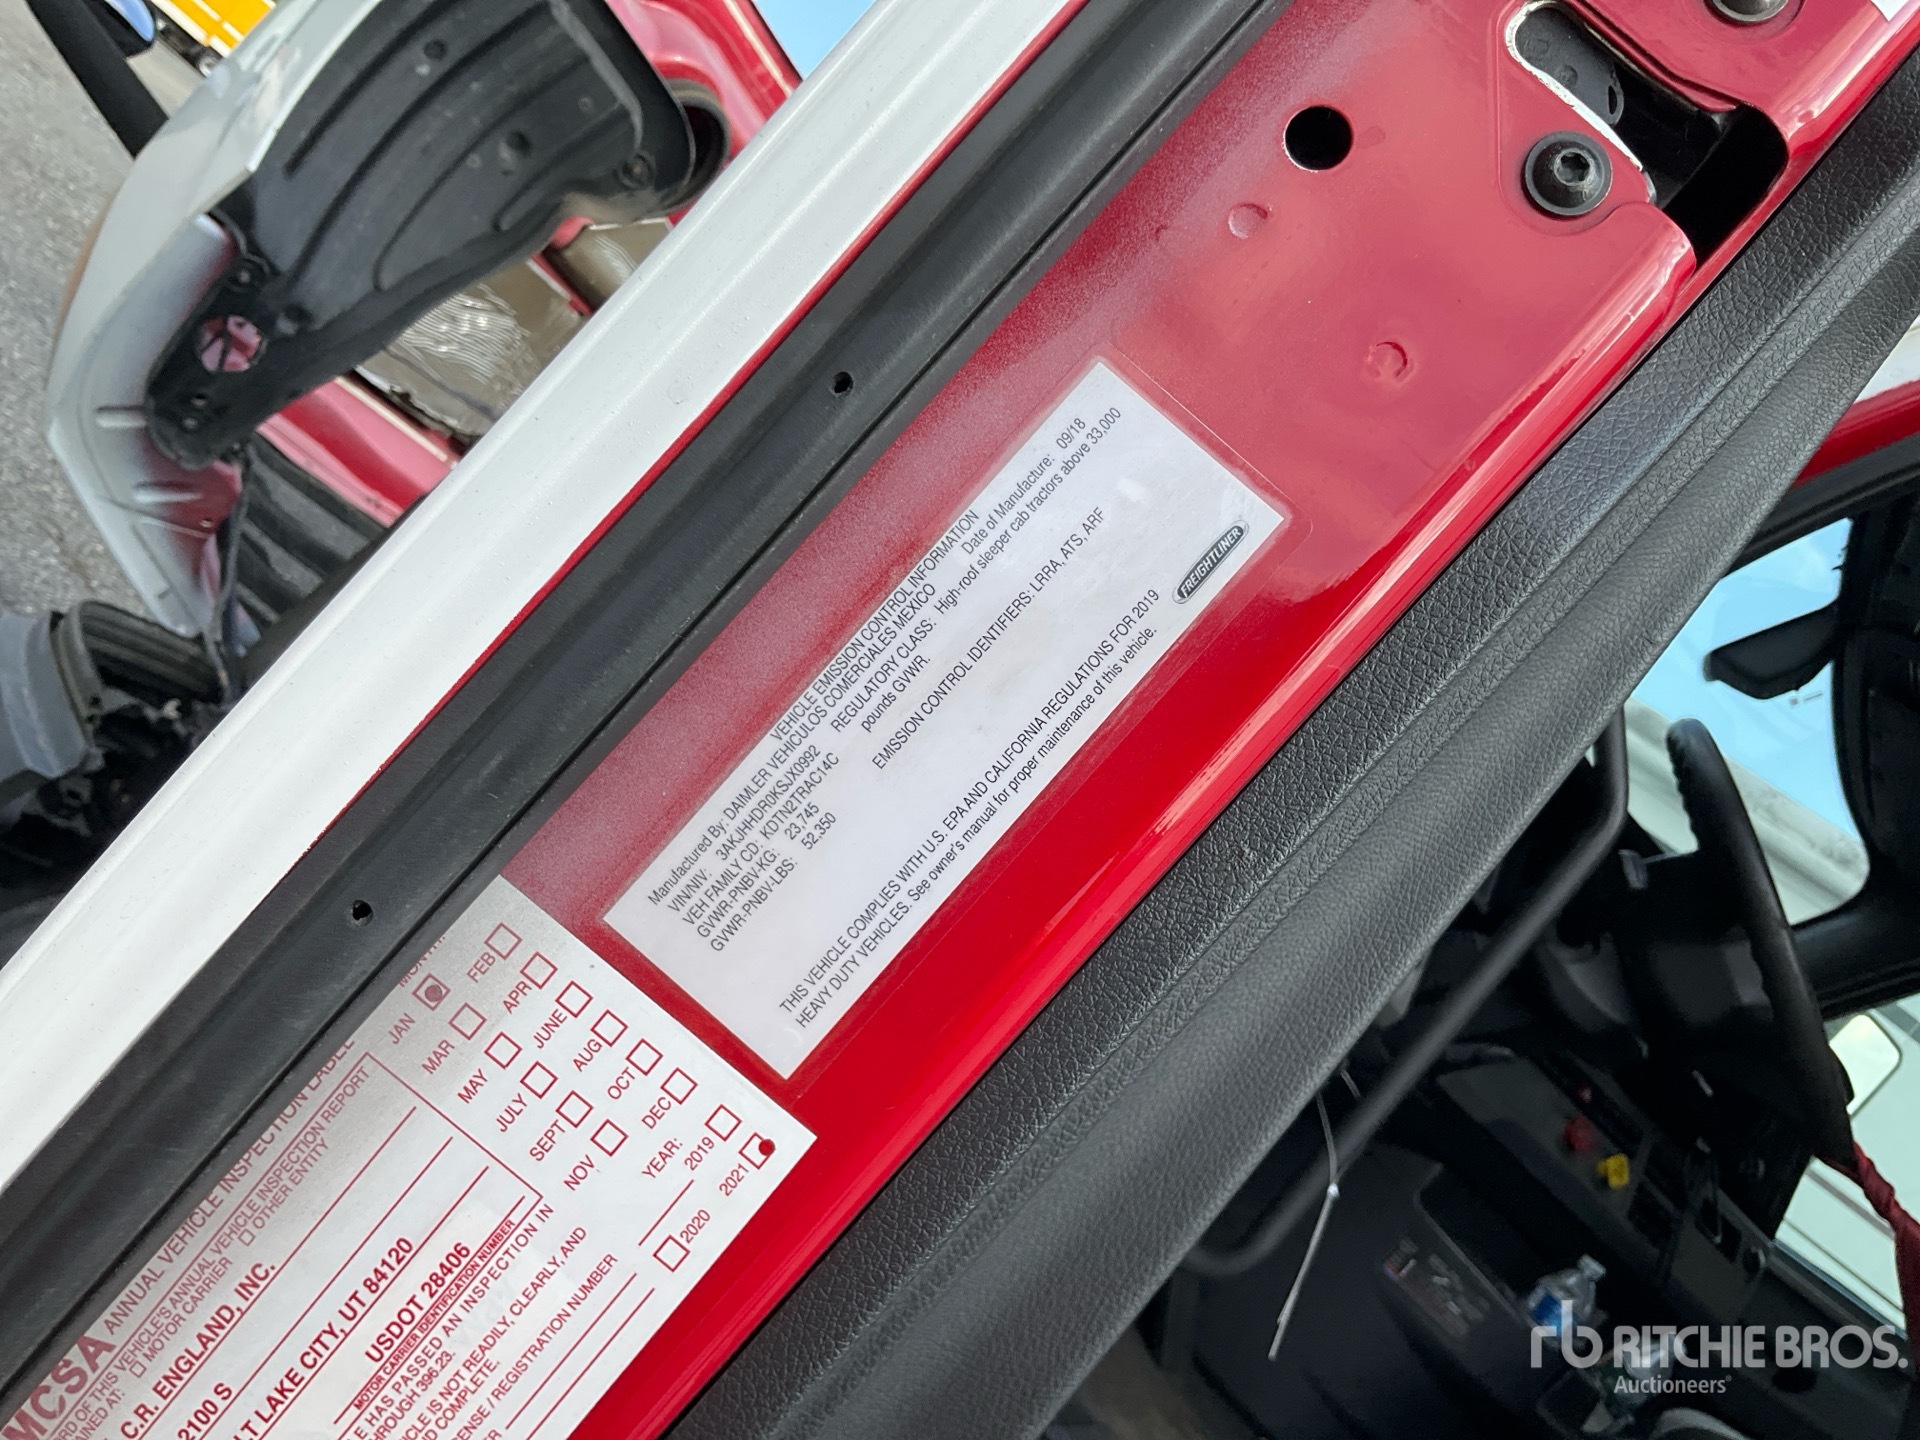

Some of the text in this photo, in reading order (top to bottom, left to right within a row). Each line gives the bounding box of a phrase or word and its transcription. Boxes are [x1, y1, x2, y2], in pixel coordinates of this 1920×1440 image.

[959, 417, 1086, 555] Date of Manufacture: 09/18
[829, 406, 1122, 733] REGULATORY CLASS: High-roof sleeper cab tractors above 33,000
[1179, 527, 1242, 597] FREIGHTLINER
[769, 508, 980, 741] VEHICLE EMISSION CONTROL INFORMATION
[871, 505, 1104, 770] EMISSION CONTROL IDENTIFIERS: LRRA, ATS, ARF
[859, 654, 931, 734] pounds GVWR.
[646, 582, 936, 906] Manufactured By: DAIMLER VEHICULOS COMERCIALES MEXICO
[681, 751, 840, 925] VEH FAMILY CD: KDTN2TRAC14C
[778, 983, 809, 1013] THIS
[802, 935, 852, 986] VEHICLE
[845, 879, 901, 939] COMPLIES
[894, 848, 928, 882] WITH
[921, 829, 949, 853] U.S.
[962, 780, 989, 810] AND
[983, 716, 1048, 784] CALIFORNIA
[1040, 639, 1115, 720] REGULATIONS
[1108, 614, 1137, 644] FOR
[1131, 588, 1160, 620] 2019
[794, 627, 1157, 1029] HEAVY DUTY VEHICLES. See owner's manual for proper maintenance of this vehicle.
[666, 868, 712, 912] VIN/NIV:
[696, 801, 820, 938] GVWR-PNBV-KG: 23,745
[709, 811, 837, 952] GVWR-PNBV-LBS: 52,350
[465, 951, 496, 984] FEB
[502, 979, 533, 1015] APR
[387, 1011, 416, 1045] JAN
[420, 1038, 456, 1075] MAR
[532, 1007, 568, 1050] JUNE
[572, 1038, 603, 1073] AUG
[456, 1067, 488, 1104] MAY
[495, 1091, 528, 1133] JULY
[606, 1065, 636, 1100] OCT
[640, 1095, 672, 1130] DEC
[528, 1118, 566, 1162] SEPT
[562, 1153, 595, 1192] NOV
[640, 1137, 683, 1179] YEAR:
[683, 1135, 715, 1172] 2019
[104, 1268, 165, 1335] ANNUAL
[158, 1195, 225, 1262] VEHICLE
[219, 1092, 309, 1194] INSPECTION
[250, 1136, 329, 1230] OTHER ENTITY
[718, 1162, 749, 1197] 2021
[73, 1399, 92, 1422] OF
[87, 1370, 119, 1402] THIS
[112, 1305, 173, 1372] VEHICLE'S
[168, 1256, 216, 1311] ANNUAL
[208, 1198, 262, 1256] VEHICLE
[254, 1119, 327, 1202] INSPECTION
[319, 1065, 370, 1124] REPORT
[678, 1208, 711, 1245] 2020
[141, 1255, 233, 1363] MOTOR CARRIER
[253, 1366, 305, 1424] LAKE
[299, 1320, 349, 1370] CITY,
[337, 1289, 367, 1322] UT
[362, 1236, 414, 1295] 84120
[350, 1217, 516, 1411] MOTOR CARRIER IDENTIFICATION NUMBER
[363, 1394, 395, 1428] HAS
[390, 1335, 443, 1395] PASSED
[441, 1312, 463, 1338] AN
[458, 1221, 539, 1314] INSPECTION
[534, 1202, 554, 1223] IN
[364, 1241, 471, 1363] USDOT 28406
[425, 1398, 444, 1416] IS
[437, 1368, 466, 1402] NOT
[461, 1314, 516, 1373] READILY,
[508, 1254, 566, 1317] CLEARLY,
[559, 1226, 587, 1259] AND
[489, 1307, 572, 1401] REGISTRATION
[565, 1253, 618, 1311] NUMBER
[119, 1262, 276, 1440] C.R. ENGLAND, INC.
[414, 1349, 456, 1393] 396.23.
[104, 1387, 126, 1410] AT:
[176, 1381, 233, 1440] 2100 S
[433, 1357, 500, 1430] COMPLETE.
